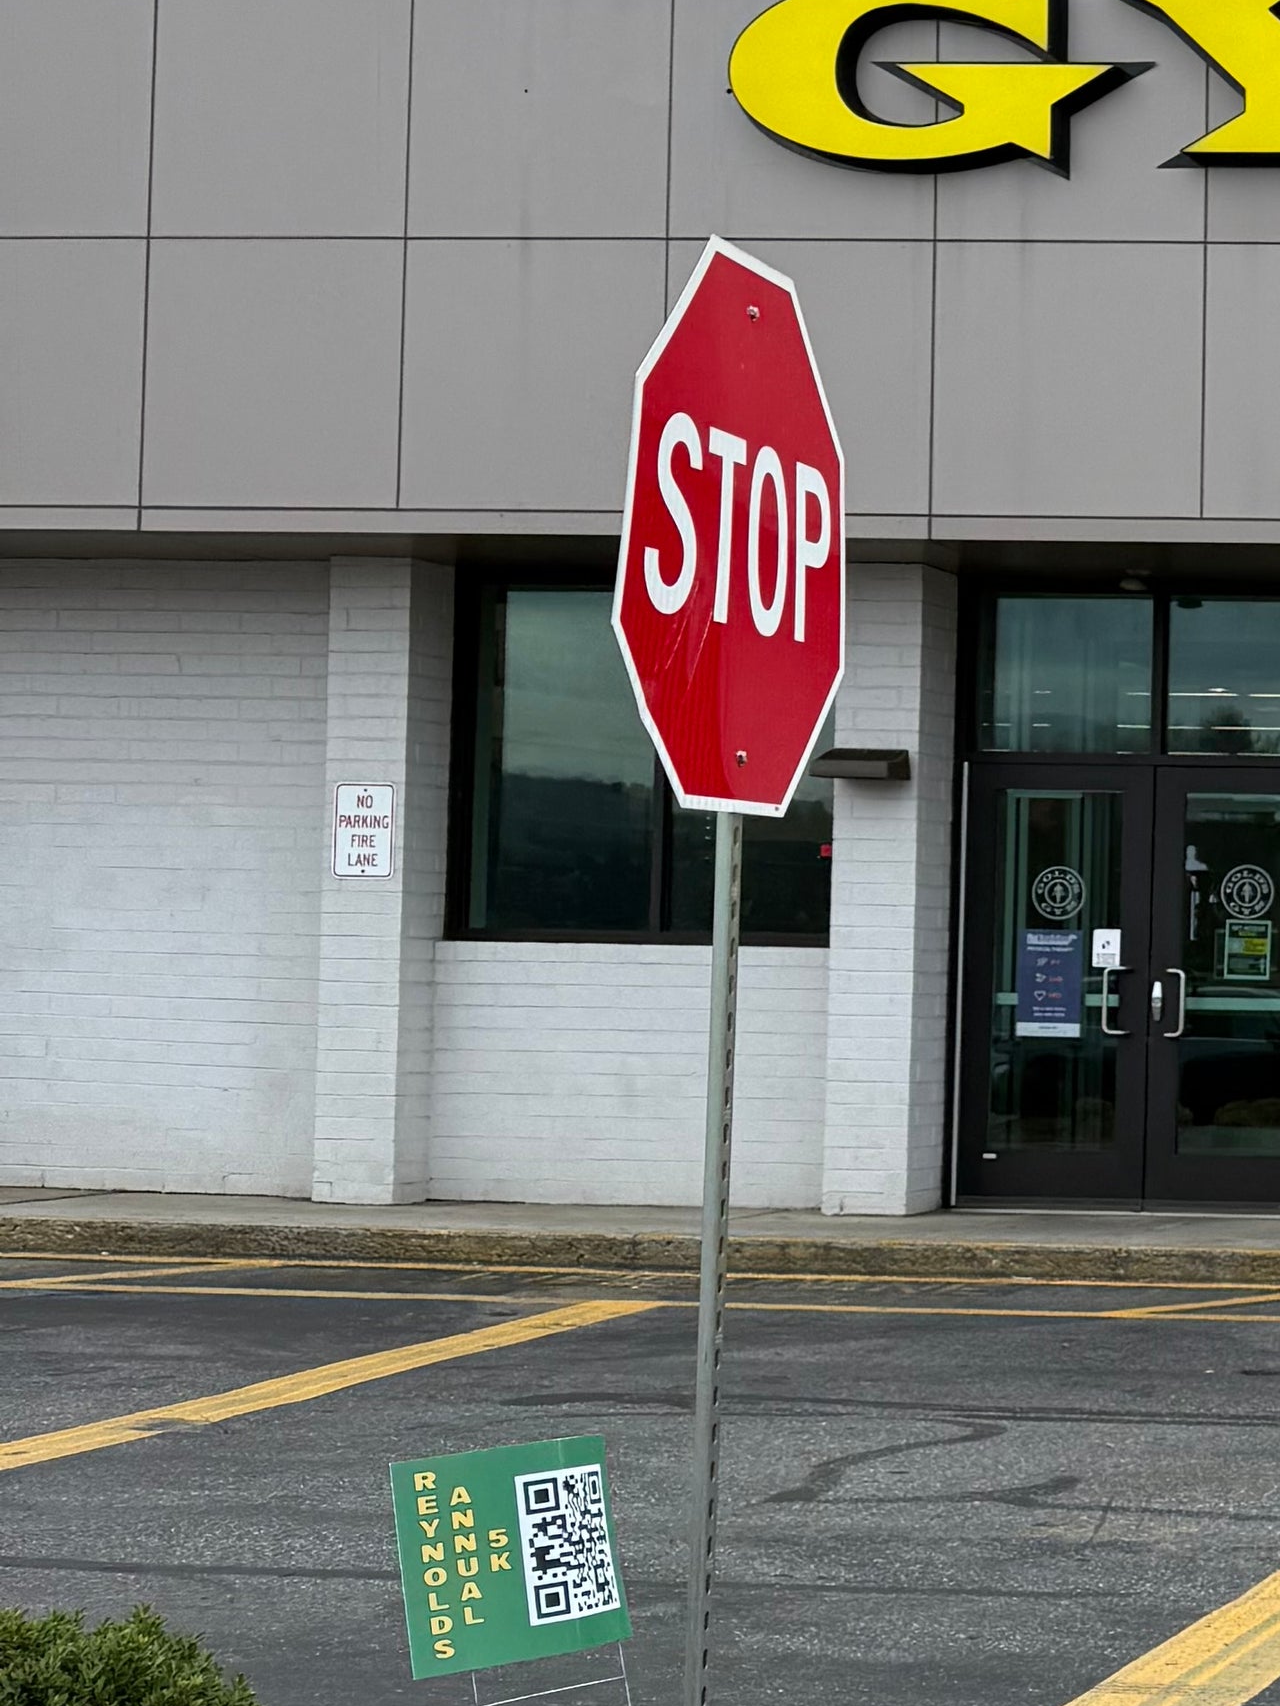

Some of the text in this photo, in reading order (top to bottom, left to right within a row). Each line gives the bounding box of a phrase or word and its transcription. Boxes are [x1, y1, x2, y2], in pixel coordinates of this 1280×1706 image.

[644, 412, 831, 643] STOP
[356, 794, 374, 809] NO
[338, 815, 389, 829] PARKING
[350, 834, 376, 848] FIRE
[347, 853, 378, 867] LANE
[413, 1470, 456, 1659] REYNOLDS
[450, 1485, 485, 1625] ANNUAL
[487, 1528, 512, 1572] 5K
